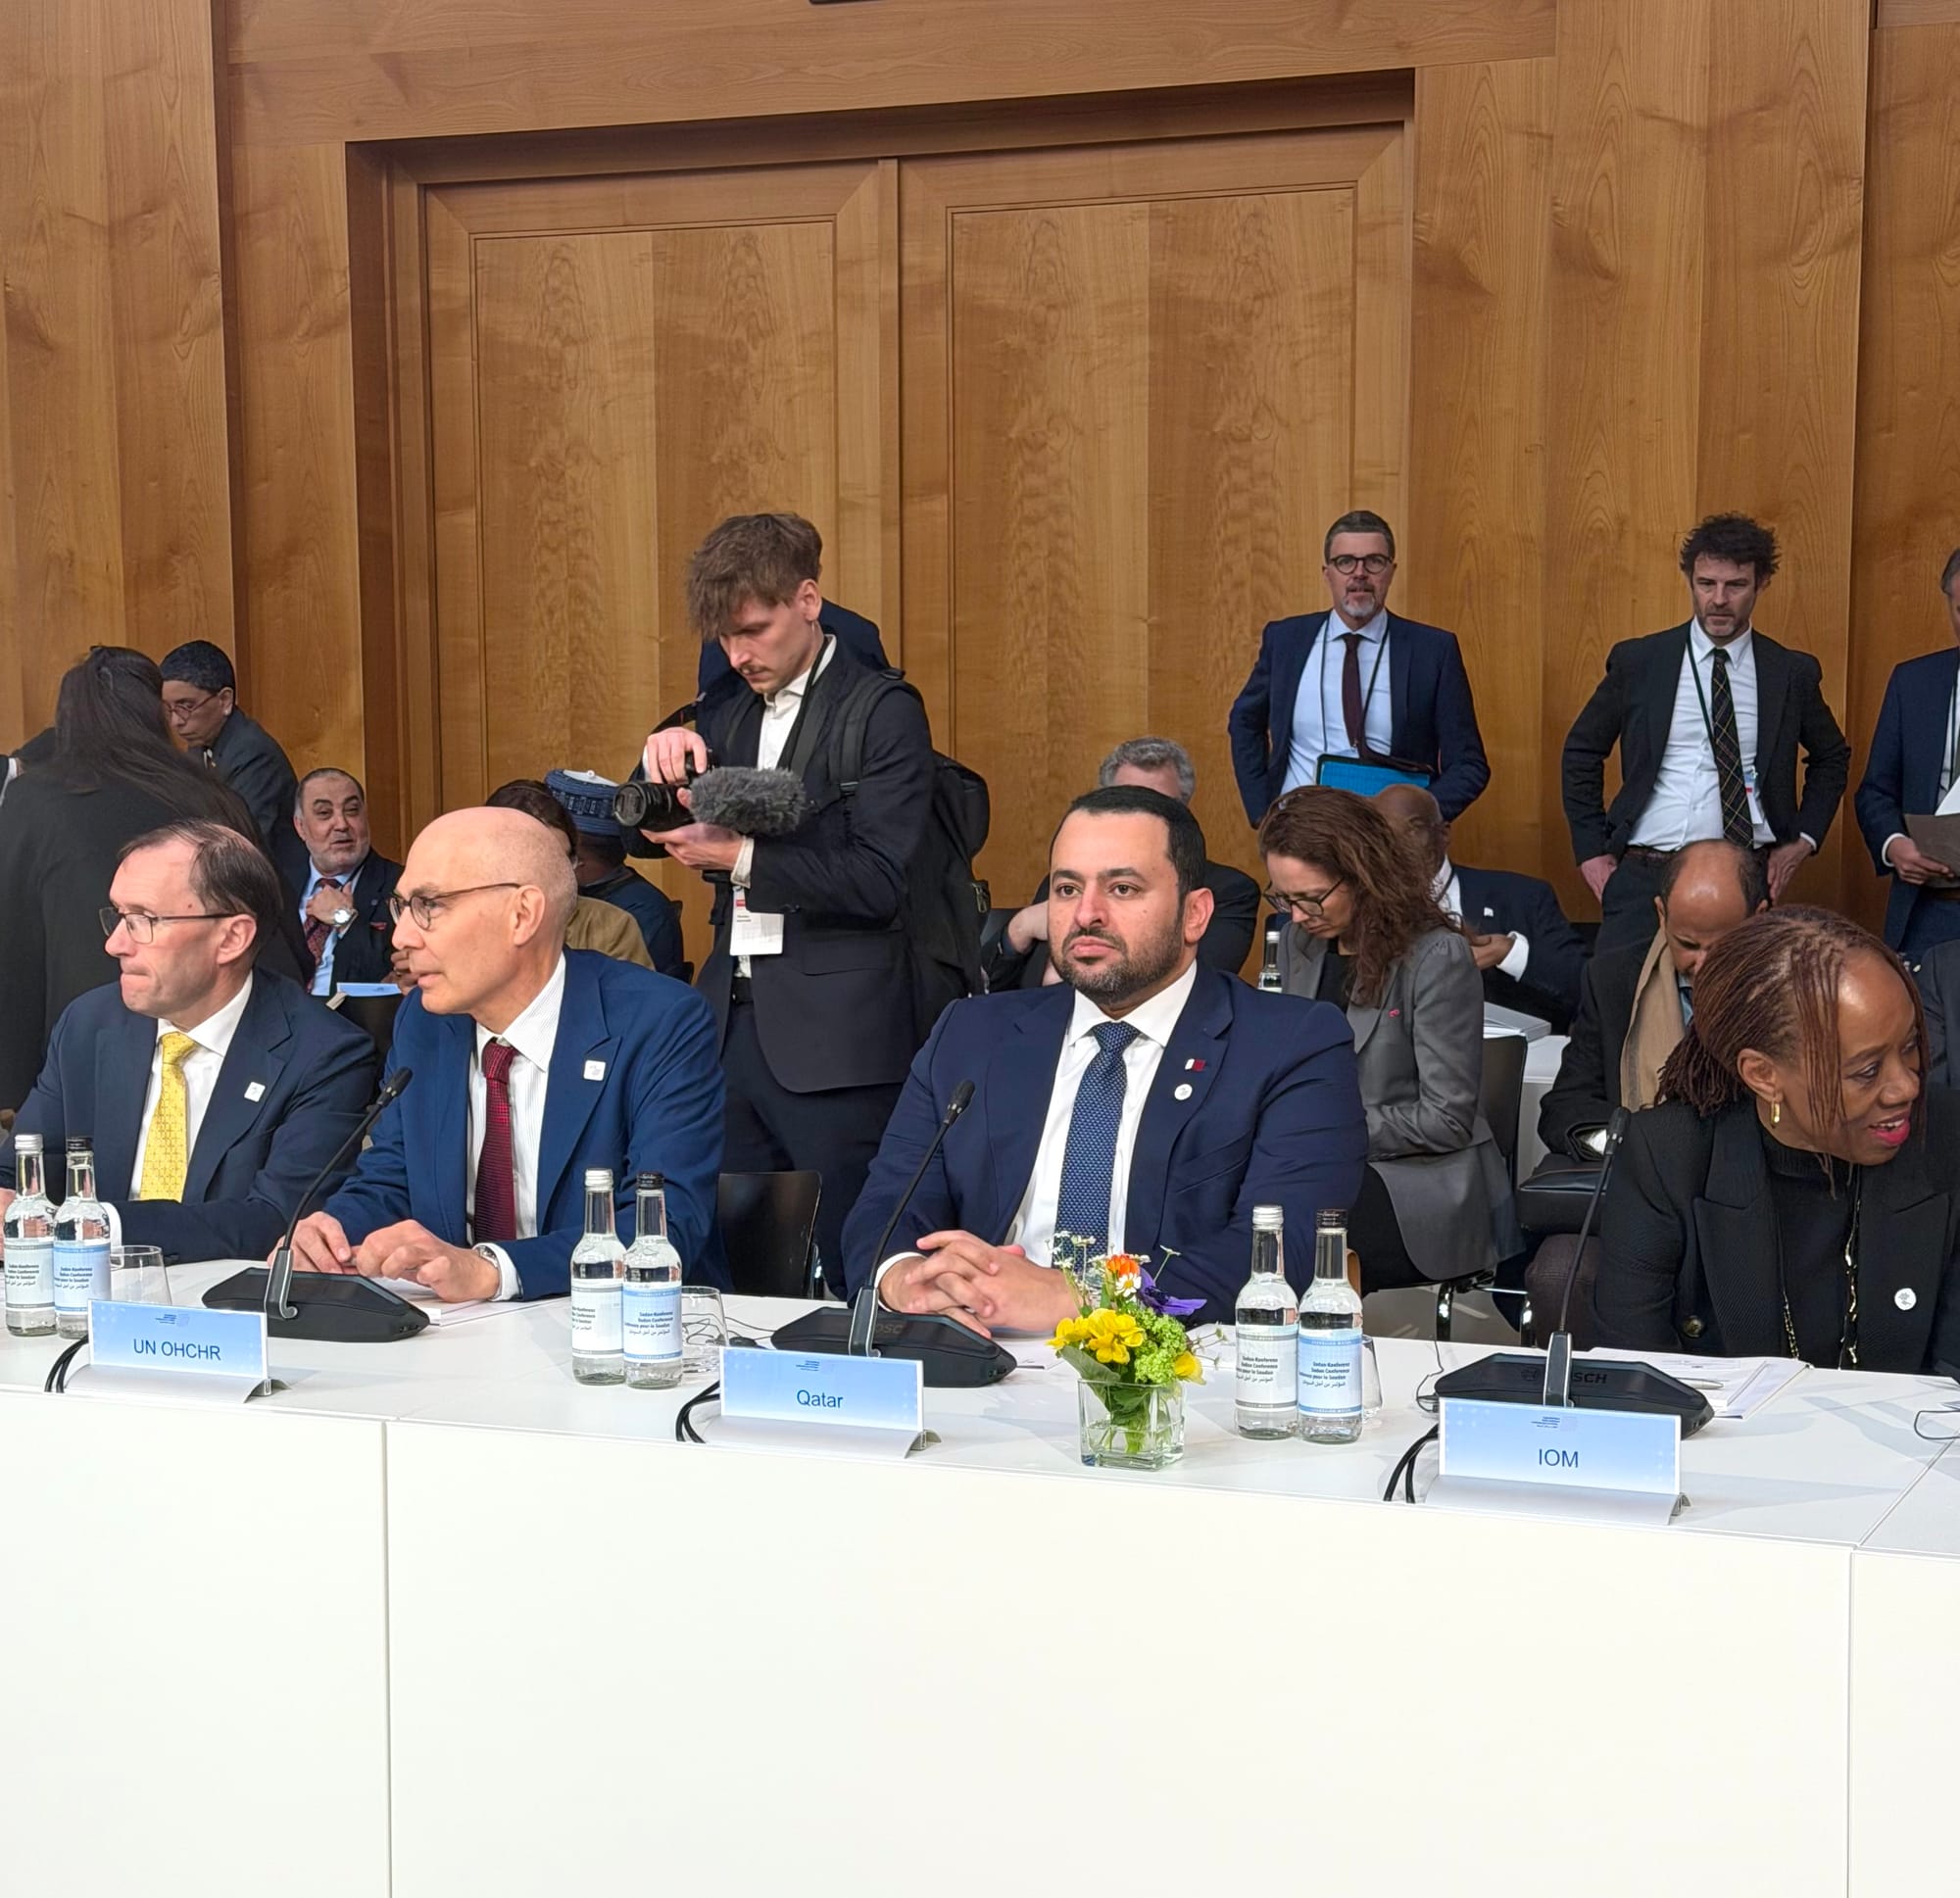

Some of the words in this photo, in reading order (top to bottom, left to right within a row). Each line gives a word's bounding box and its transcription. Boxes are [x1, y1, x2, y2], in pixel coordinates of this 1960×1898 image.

[133, 1338, 156, 1355] UN
[161, 1340, 221, 1361] OHCHR
[1572, 1372, 1608, 1384] SCH
[797, 1389, 844, 1408] Qatar
[1539, 1448, 1579, 1468] IOM
